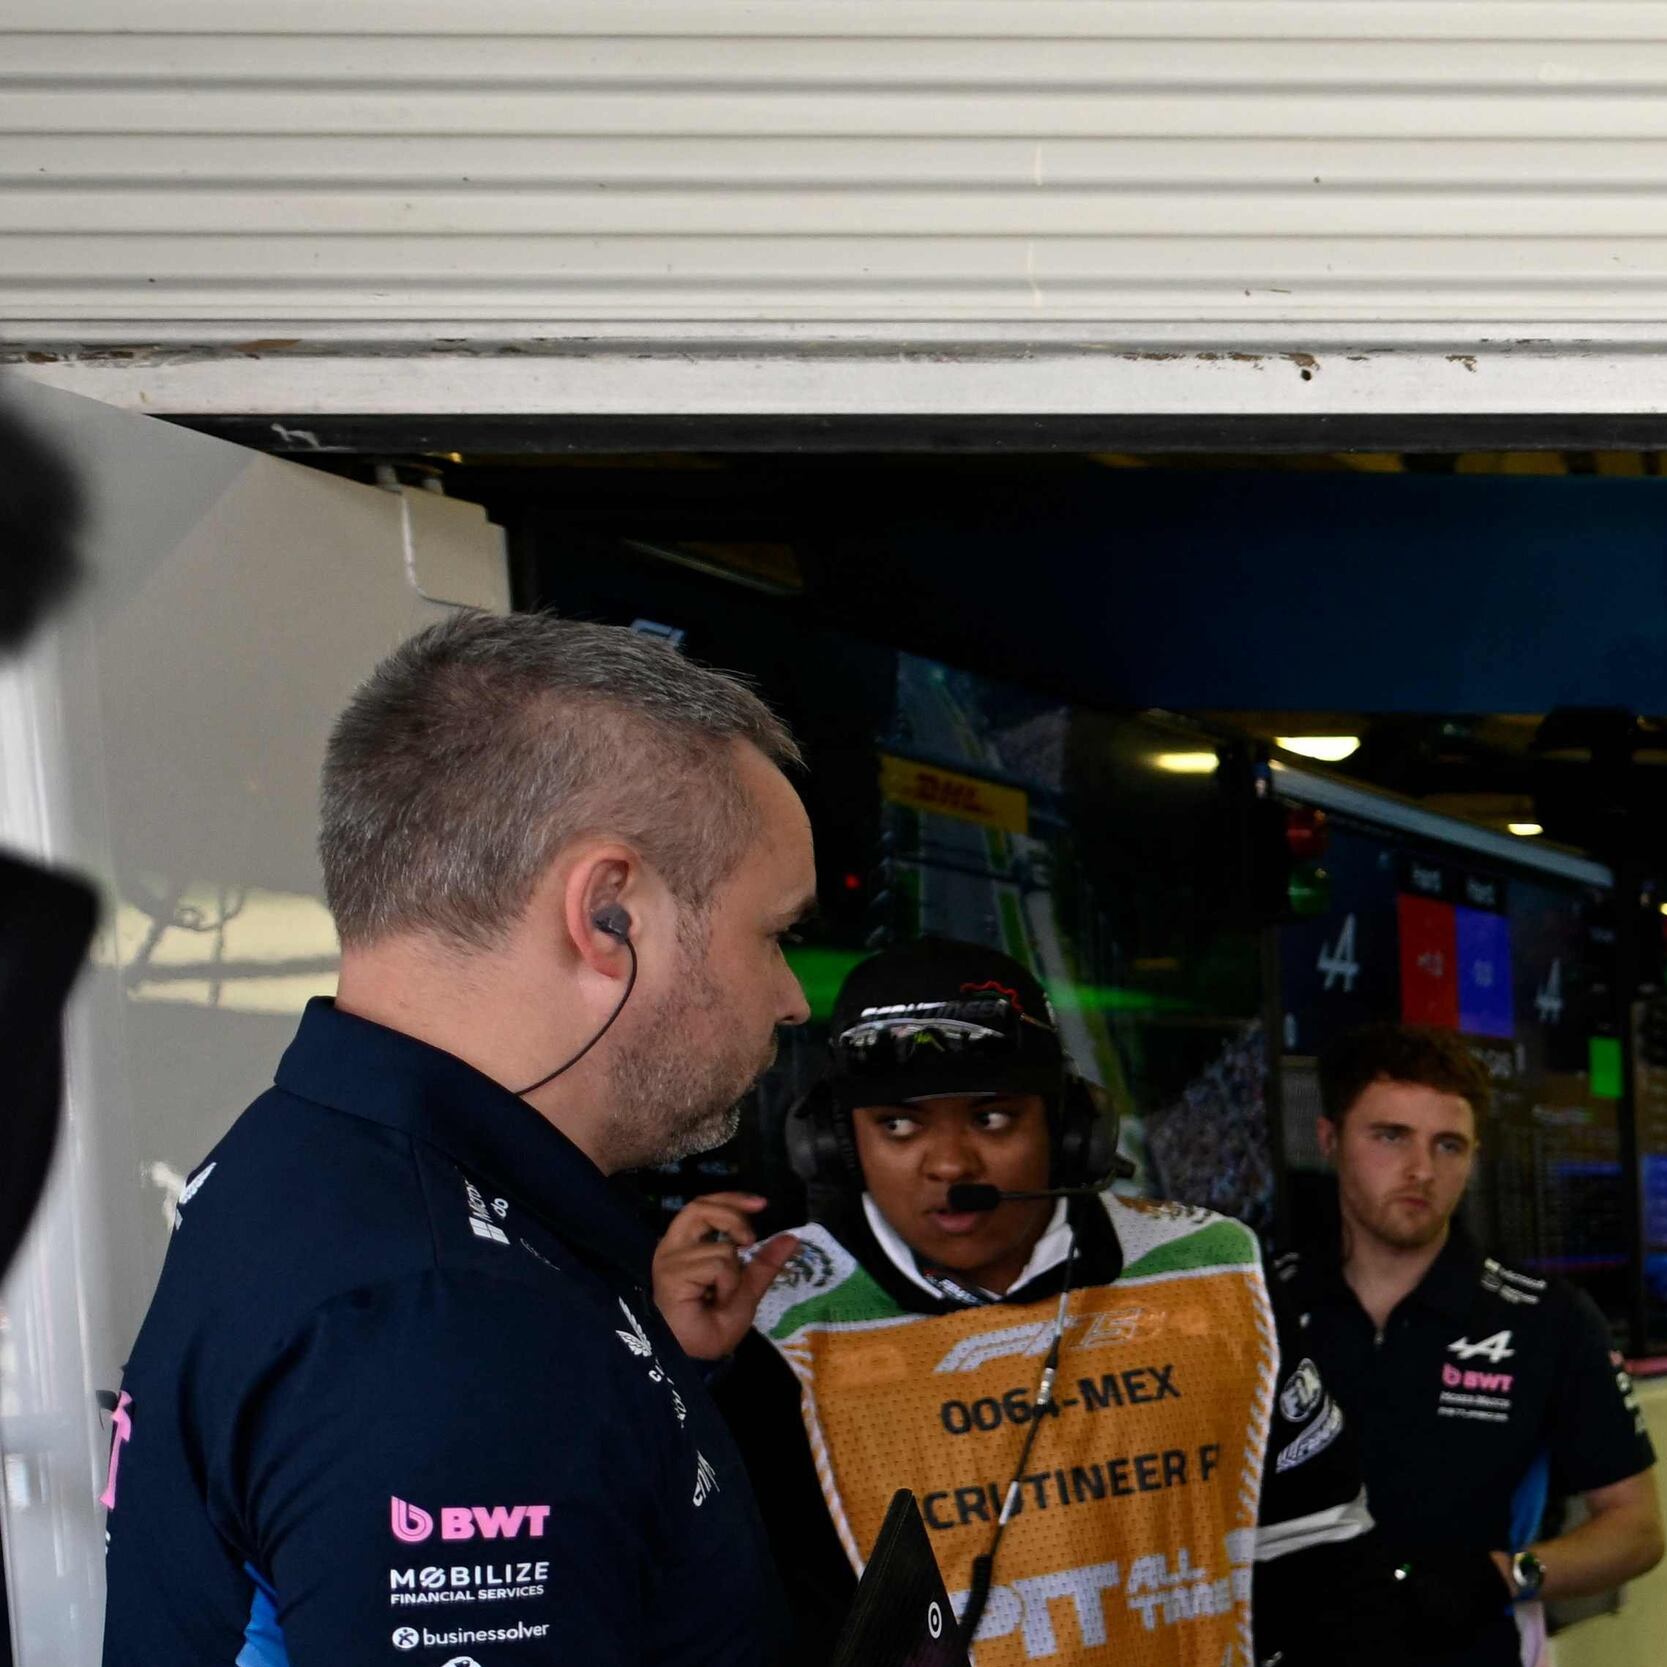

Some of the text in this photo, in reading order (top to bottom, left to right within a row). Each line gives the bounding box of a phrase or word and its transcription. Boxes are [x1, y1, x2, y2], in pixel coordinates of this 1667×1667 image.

[923, 1449, 1188, 1530] CRUTINEER
[441, 1505, 551, 1540] BWT
[390, 1584, 545, 1606] FINANCIAL SERVICES
[423, 1621, 550, 1645] businessolver
